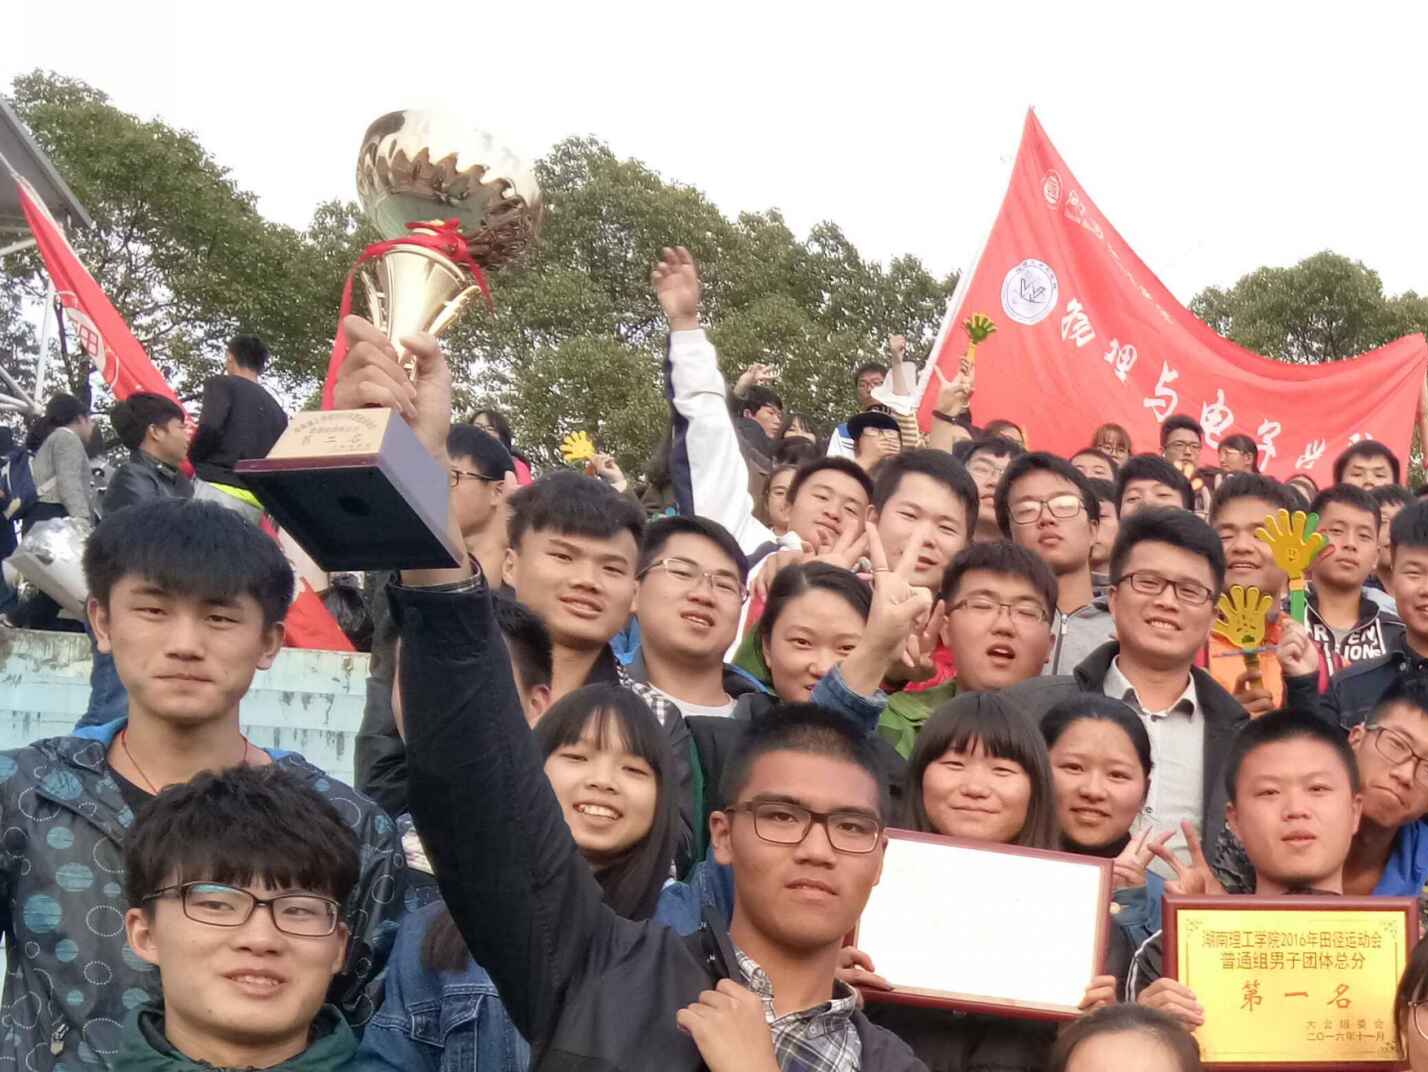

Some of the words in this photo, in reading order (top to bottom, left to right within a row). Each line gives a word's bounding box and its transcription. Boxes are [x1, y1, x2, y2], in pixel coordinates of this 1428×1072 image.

[1060, 298, 1374, 472] 物理与电子学
[1220, 951, 1366, 970] 普通组男子团体总分
[1240, 979, 1353, 1012] 第一名
